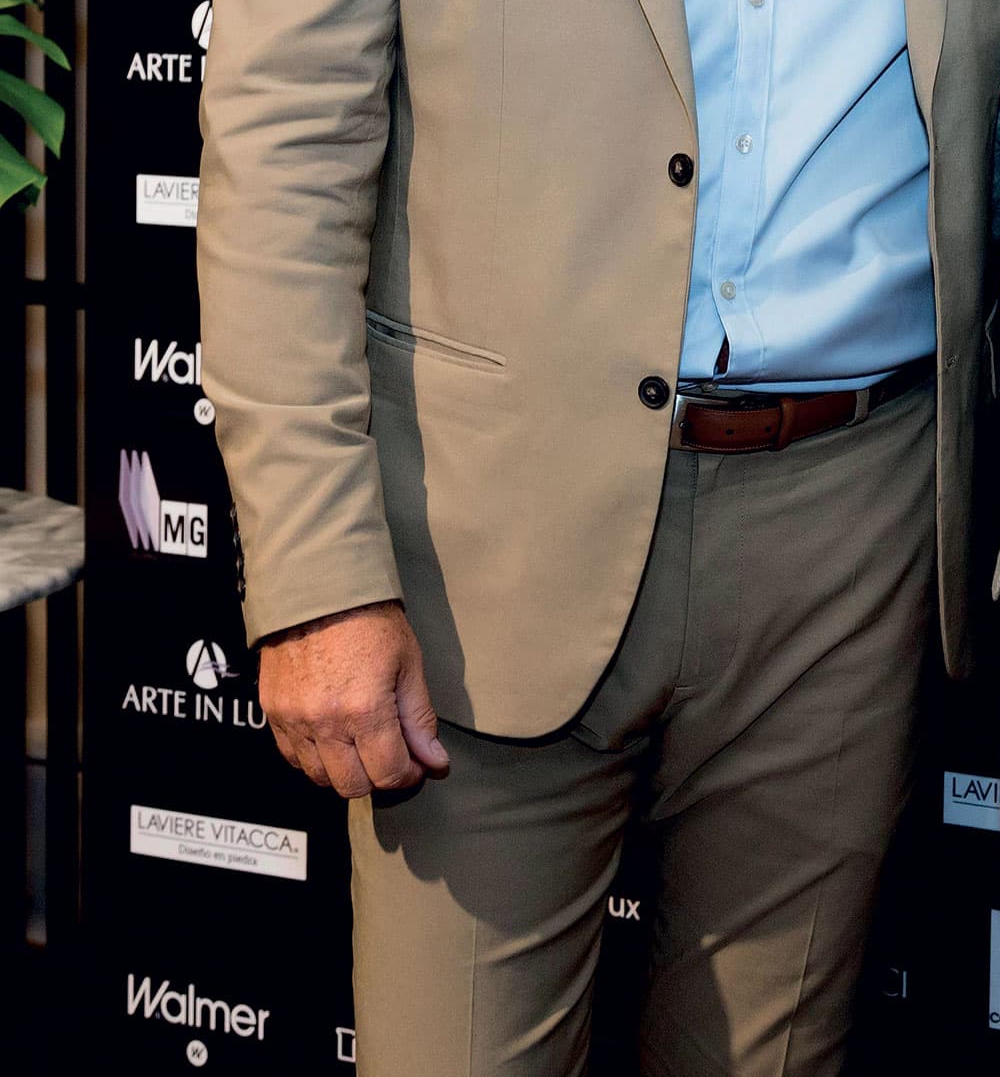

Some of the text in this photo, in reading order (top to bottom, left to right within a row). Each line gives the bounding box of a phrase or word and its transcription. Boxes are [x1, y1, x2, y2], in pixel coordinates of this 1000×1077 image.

[126, 51, 192, 83] ARTE
[164, 514, 205, 545] MG
[121, 684, 187, 719] ARTE
[195, 693, 224, 724] IN
[137, 811, 206, 840] LAVIERE
[126, 973, 271, 1041] Walmer
